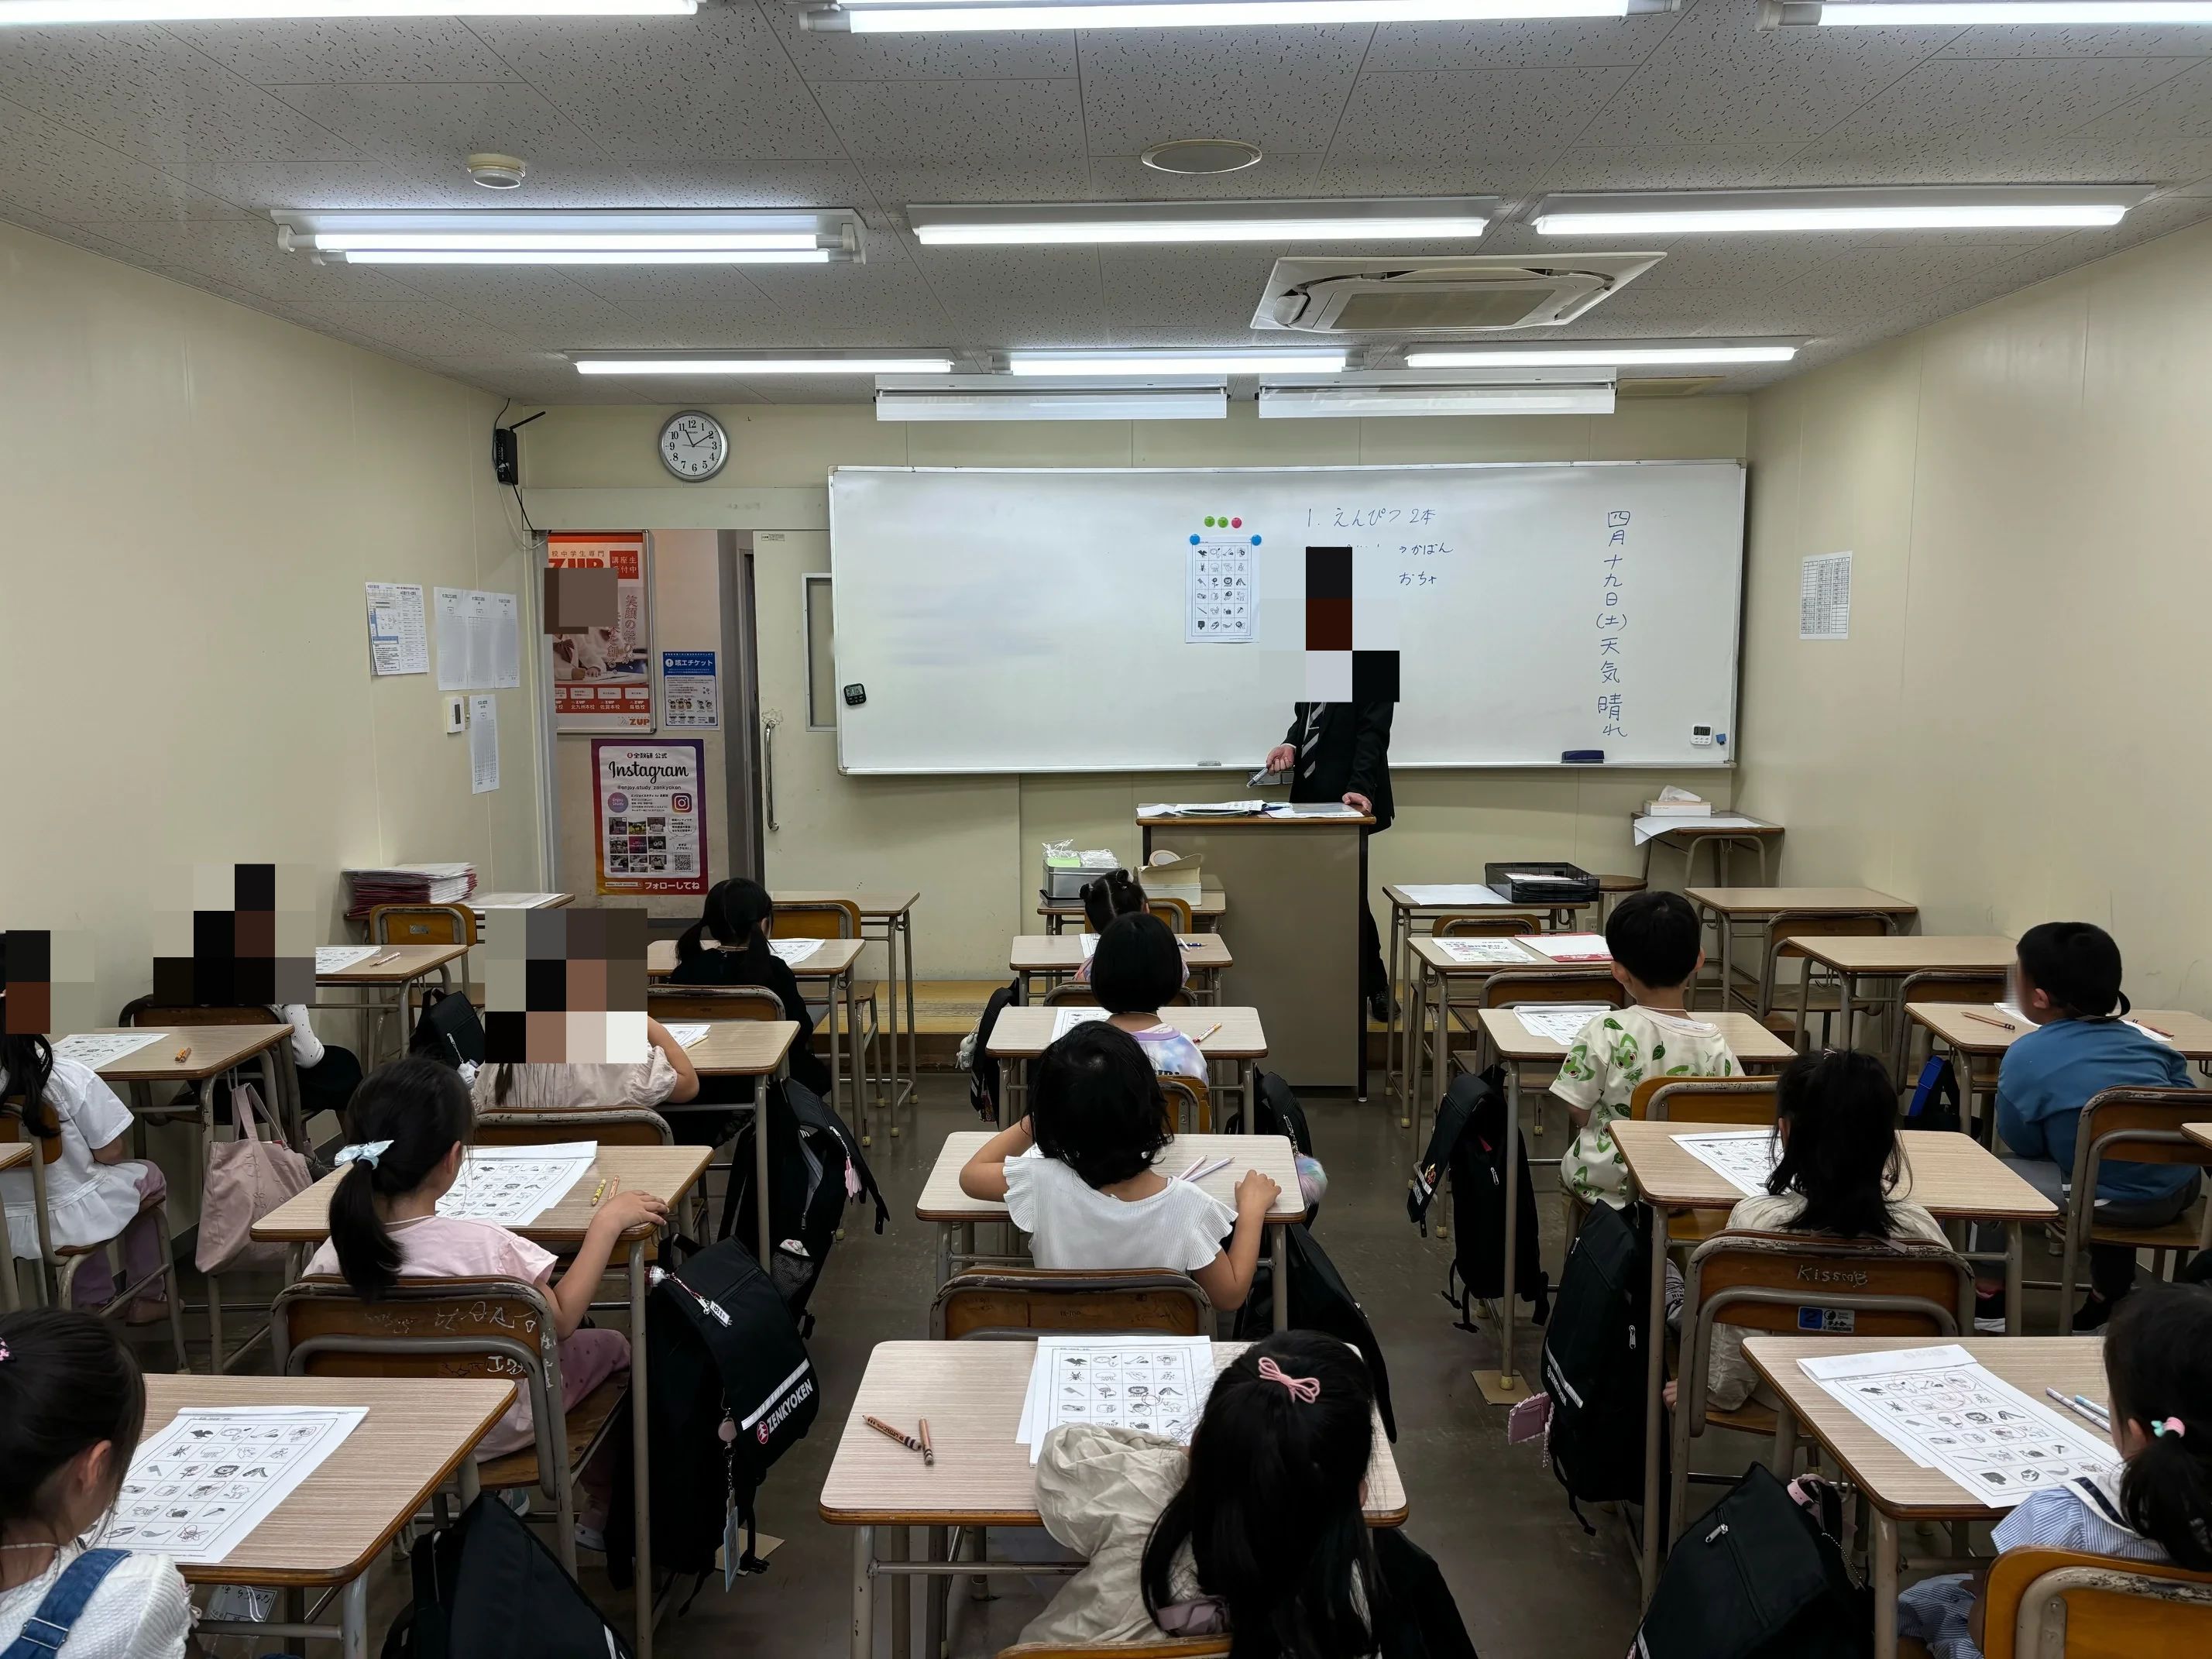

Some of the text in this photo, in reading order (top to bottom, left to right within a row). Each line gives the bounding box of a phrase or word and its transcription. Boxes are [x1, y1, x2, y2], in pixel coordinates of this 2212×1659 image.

[678, 423, 685, 431] 11
[688, 420, 696, 428] 12
[701, 423, 705, 431] 1
[671, 431, 679, 439] 10
[708, 431, 714, 439] 2
[669, 441, 675, 450] 9
[712, 441, 717, 450] 3
[672, 452, 678, 461] 8
[709, 452, 715, 461] 4
[681, 460, 686, 469] 7
[692, 463, 697, 472] 6
[702, 460, 708, 469] 5
[1333, 507, 1401, 527] えんぴつ
[1409, 508, 1436, 525] 2本
[608, 761, 689, 784] Instagram
[644, 881, 700, 890] フォローしてね
[767, 1378, 813, 1434] ZENKYOKEN
